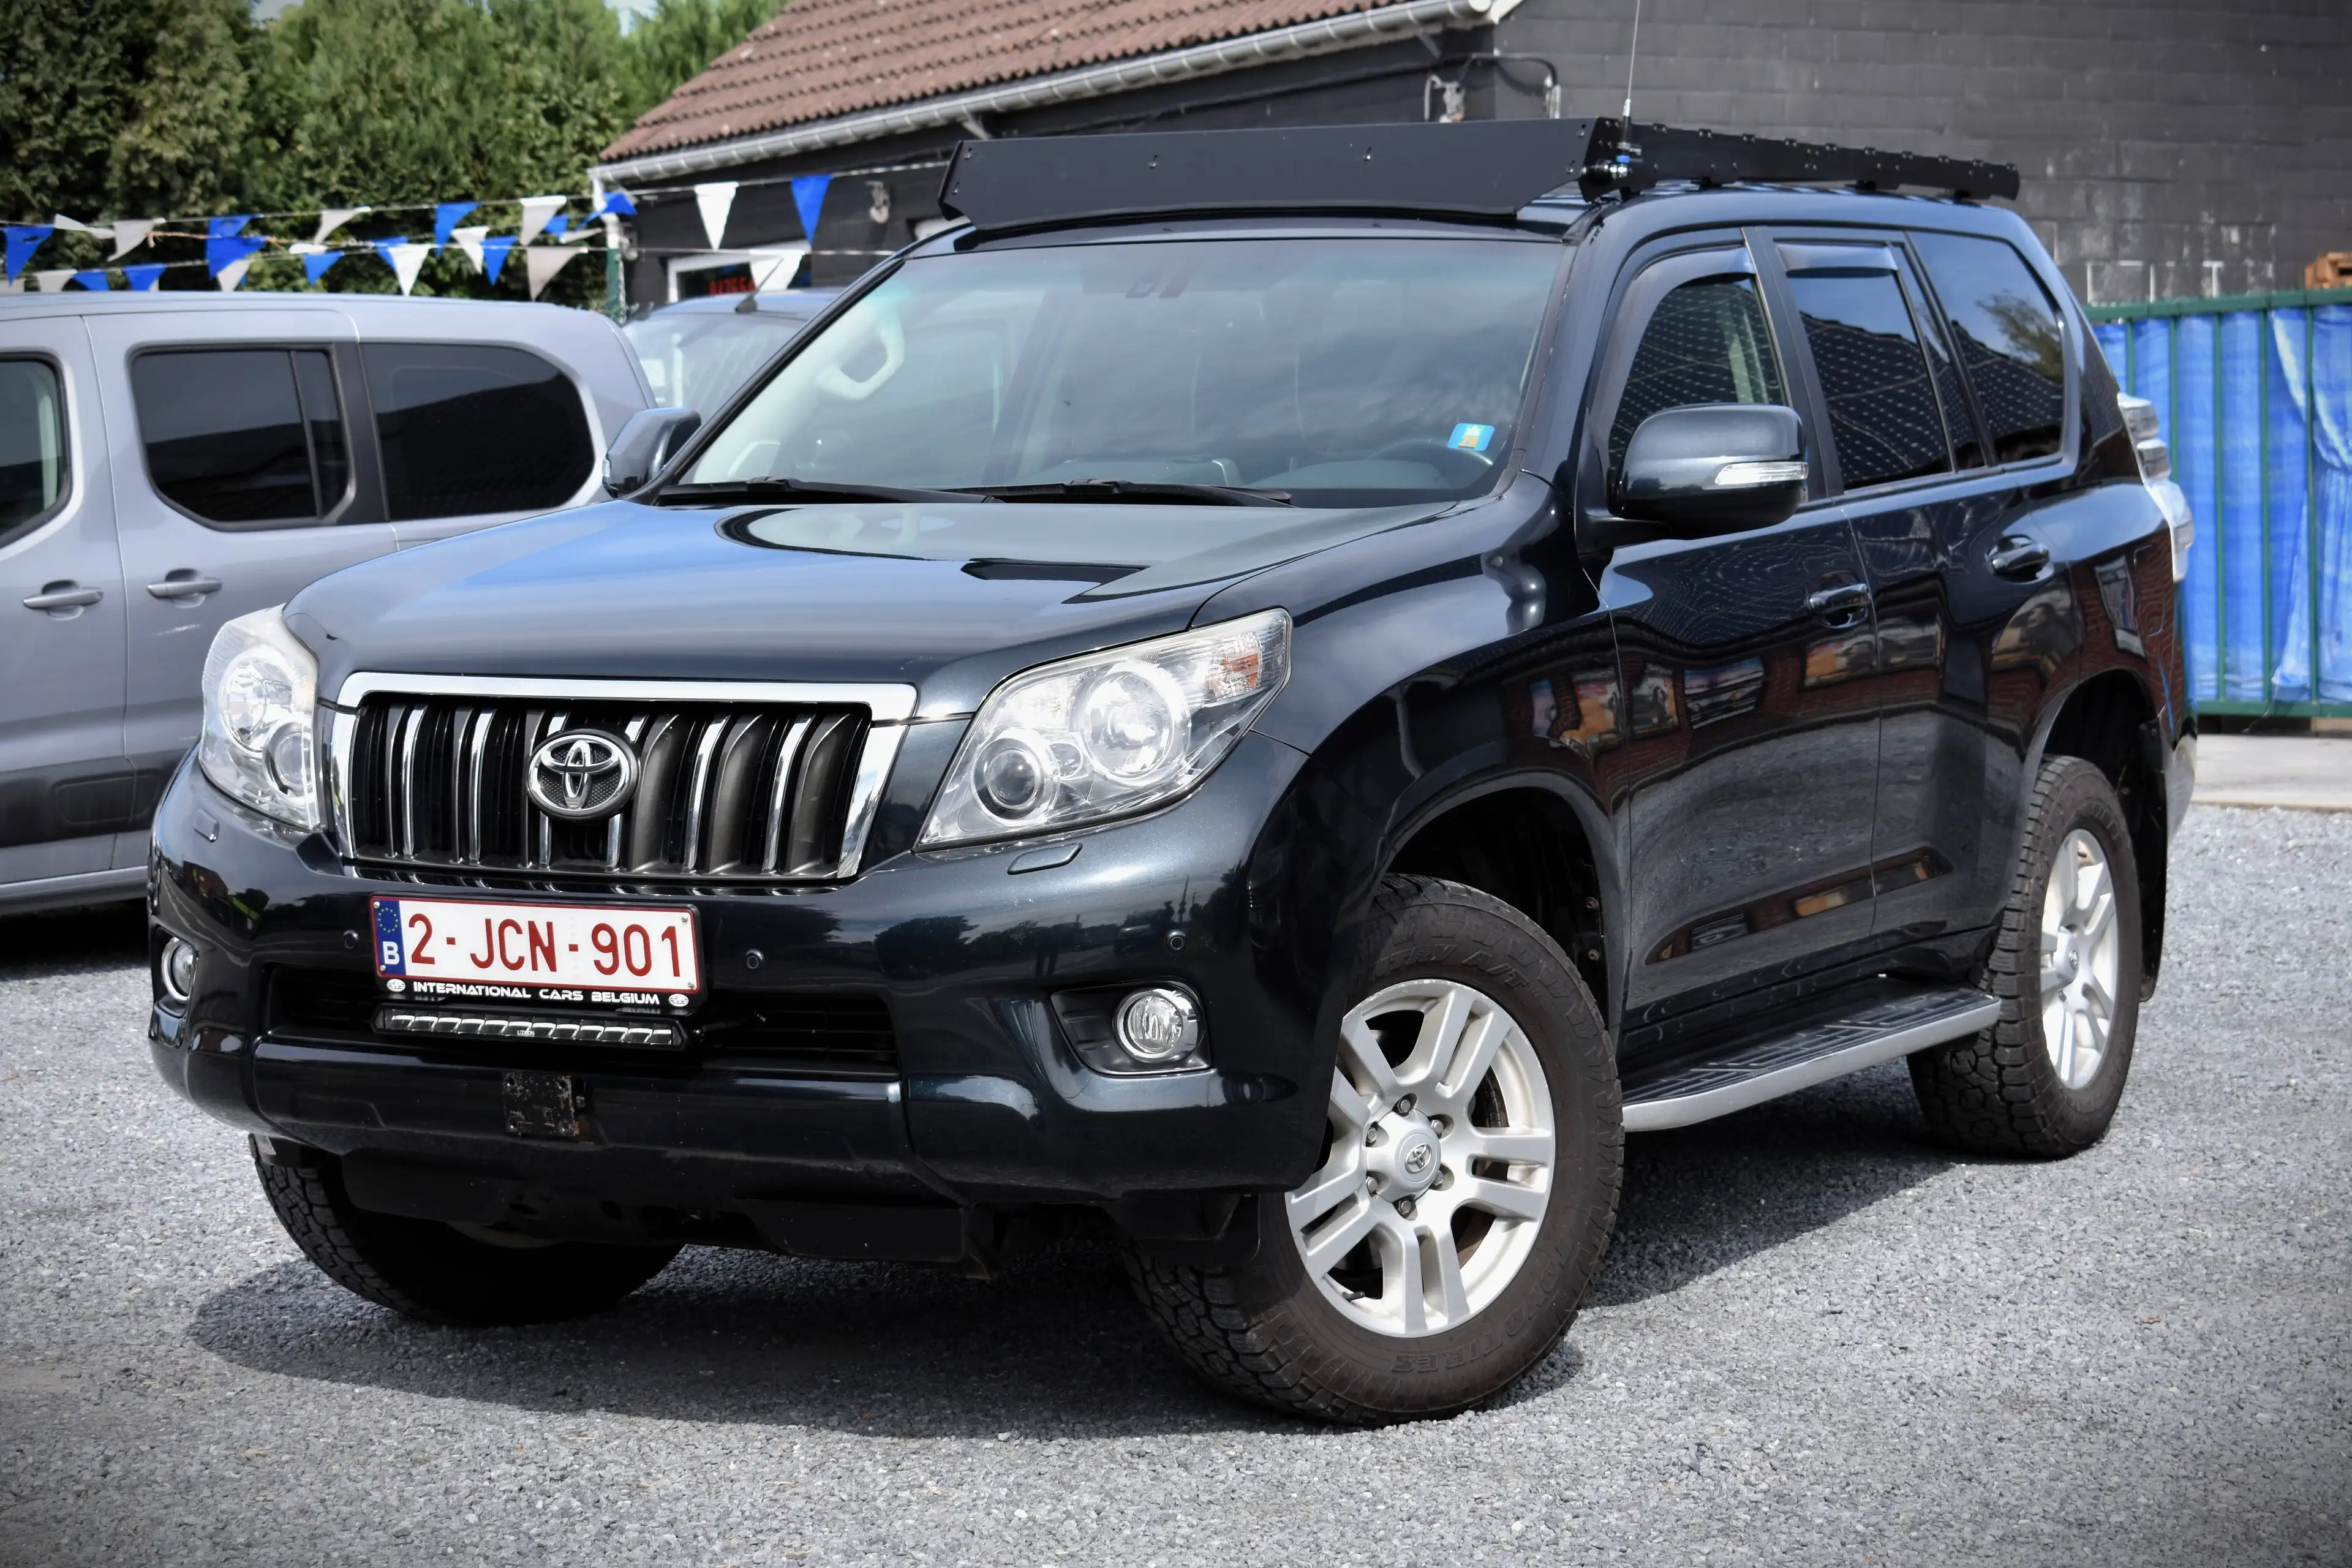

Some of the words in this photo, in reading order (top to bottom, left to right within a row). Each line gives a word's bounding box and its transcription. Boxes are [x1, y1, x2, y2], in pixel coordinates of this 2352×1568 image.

[383, 941, 400, 965] B
[409, 913, 680, 977] 2-JCN-901
[413, 981, 532, 998] INTERNATIONAL
[539, 989, 584, 1001] CARS
[591, 991, 660, 1005] BELGIUM
[1391, 1329, 1501, 1373] TIRES
